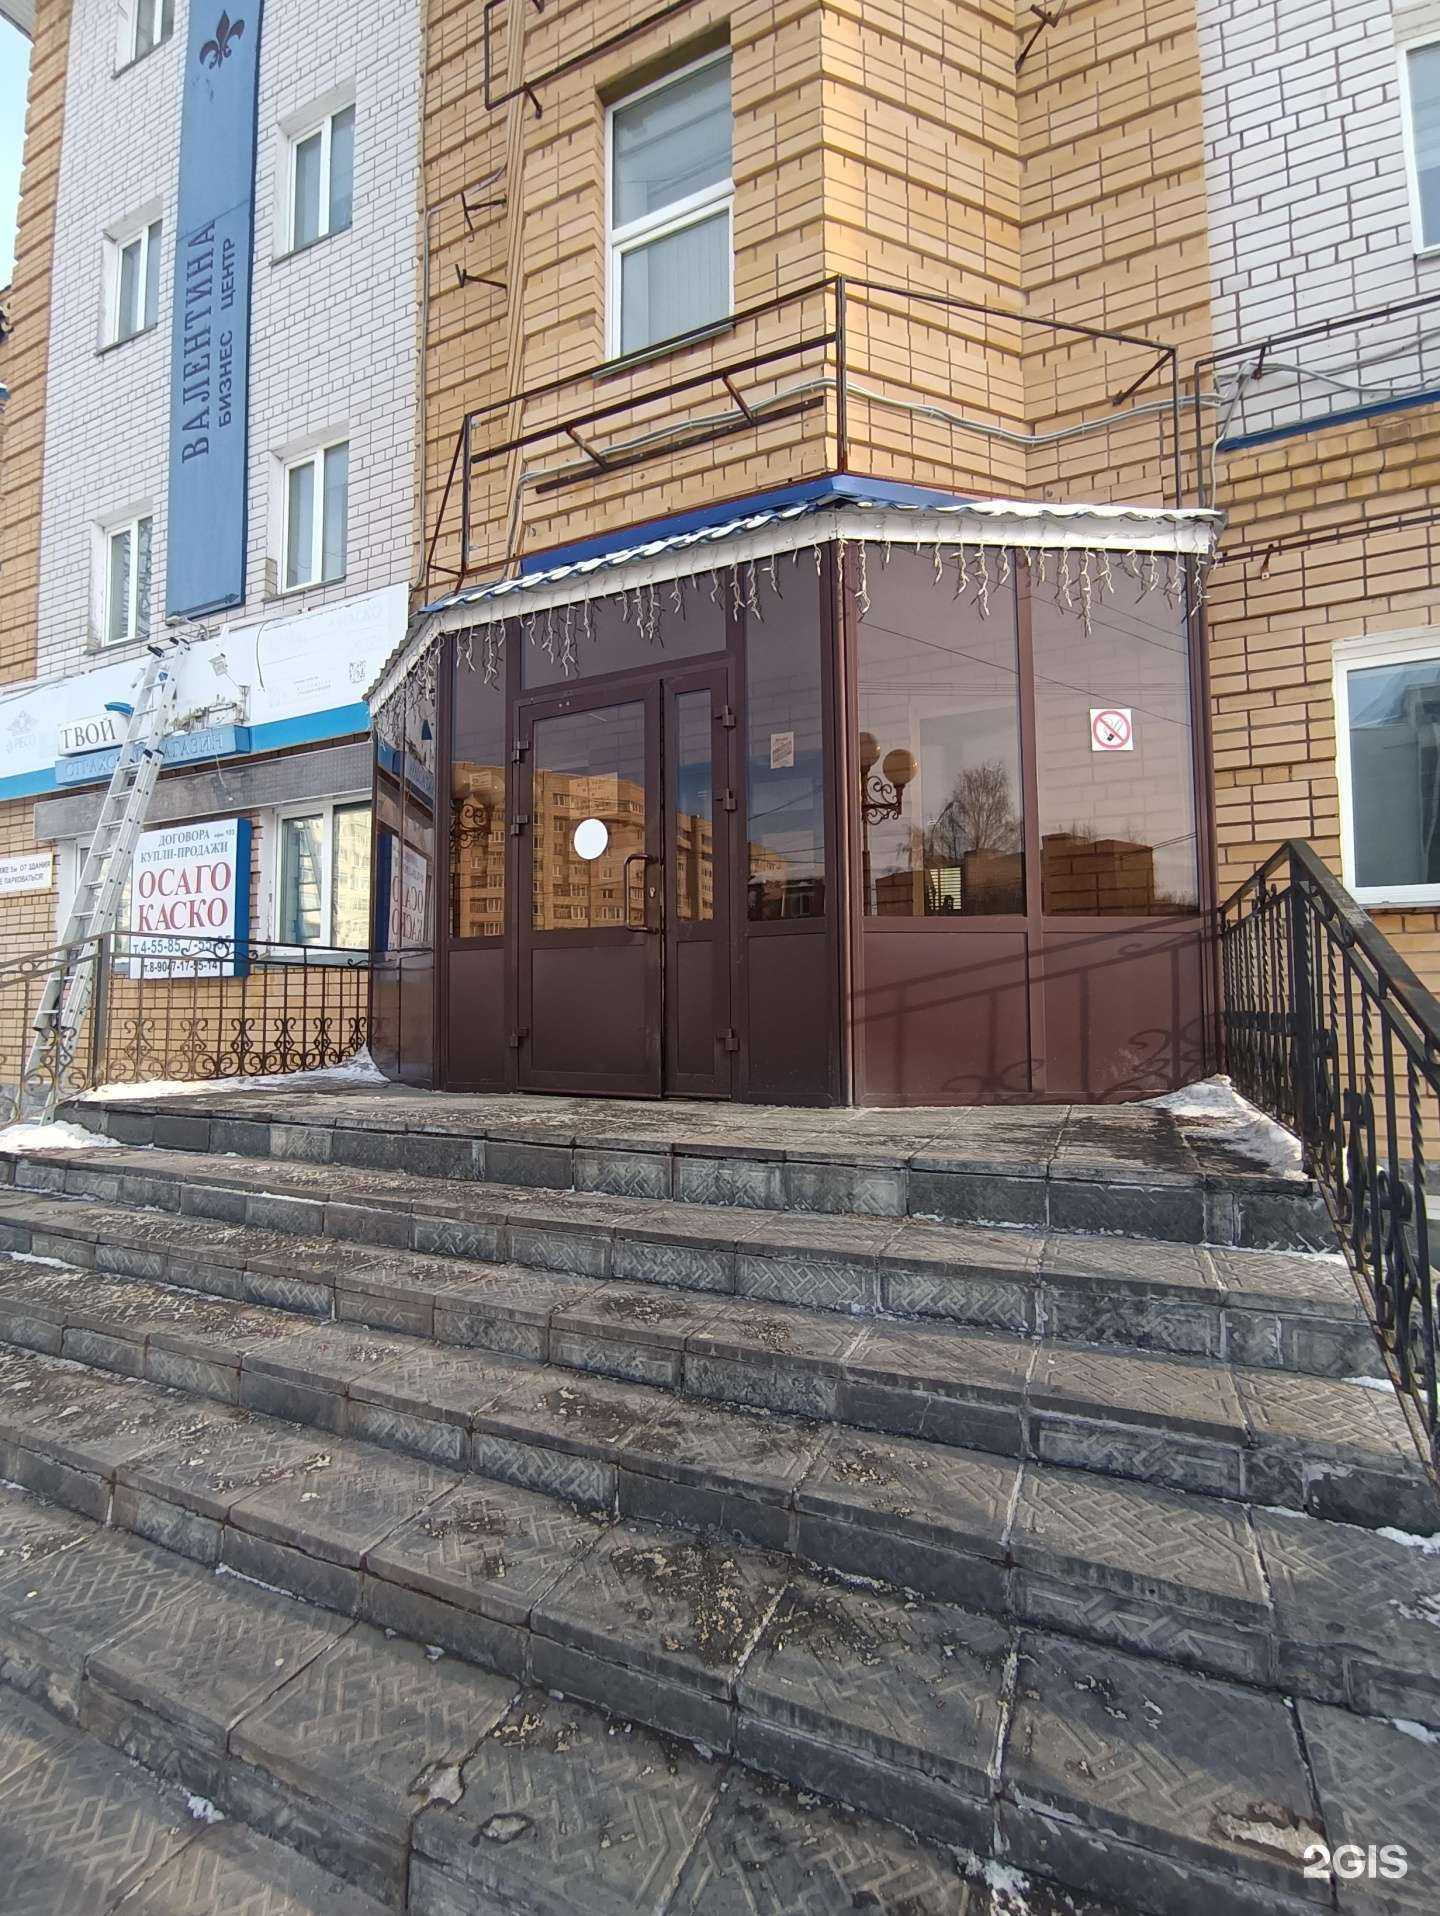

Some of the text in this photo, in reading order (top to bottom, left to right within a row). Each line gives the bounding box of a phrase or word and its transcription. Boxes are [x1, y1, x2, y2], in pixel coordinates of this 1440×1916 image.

[181, 219, 216, 464] ВАЛЕНТИНА
[218, 238, 236, 428] БИЗНЕС ЦЕНТР
[61, 716, 116, 749] ТВОЙ
[140, 841, 228, 863] КУПЛИ-ПРОДАЖИ
[158, 829, 210, 847] ДОГОВОРА
[138, 861, 232, 899] ОСАГО
[138, 897, 228, 932] КАСКО
